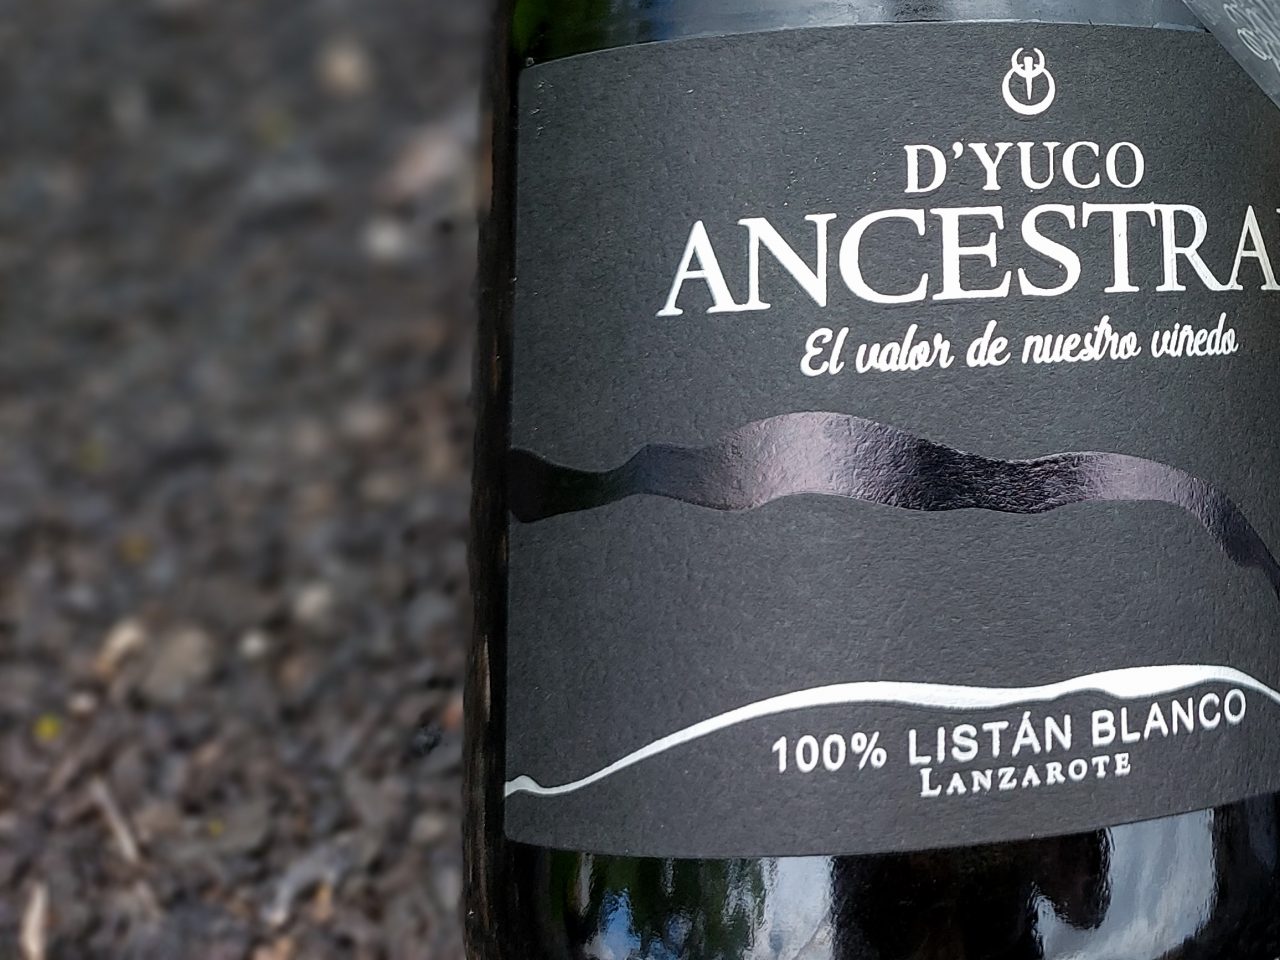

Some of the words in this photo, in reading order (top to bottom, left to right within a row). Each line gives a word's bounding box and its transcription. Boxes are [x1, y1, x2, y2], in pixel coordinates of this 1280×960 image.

[903, 140, 1146, 194] D'YUCO
[799, 327, 844, 377] El
[854, 323, 954, 375] valor
[965, 319, 1013, 368] de
[1021, 314, 1142, 365] nuestro
[1149, 311, 1240, 359] viñedo
[771, 730, 888, 775] 100%
[908, 711, 1073, 766] LISTÁN
[1091, 688, 1248, 748] BLANCO
[919, 752, 1132, 798] LANZAROTE
